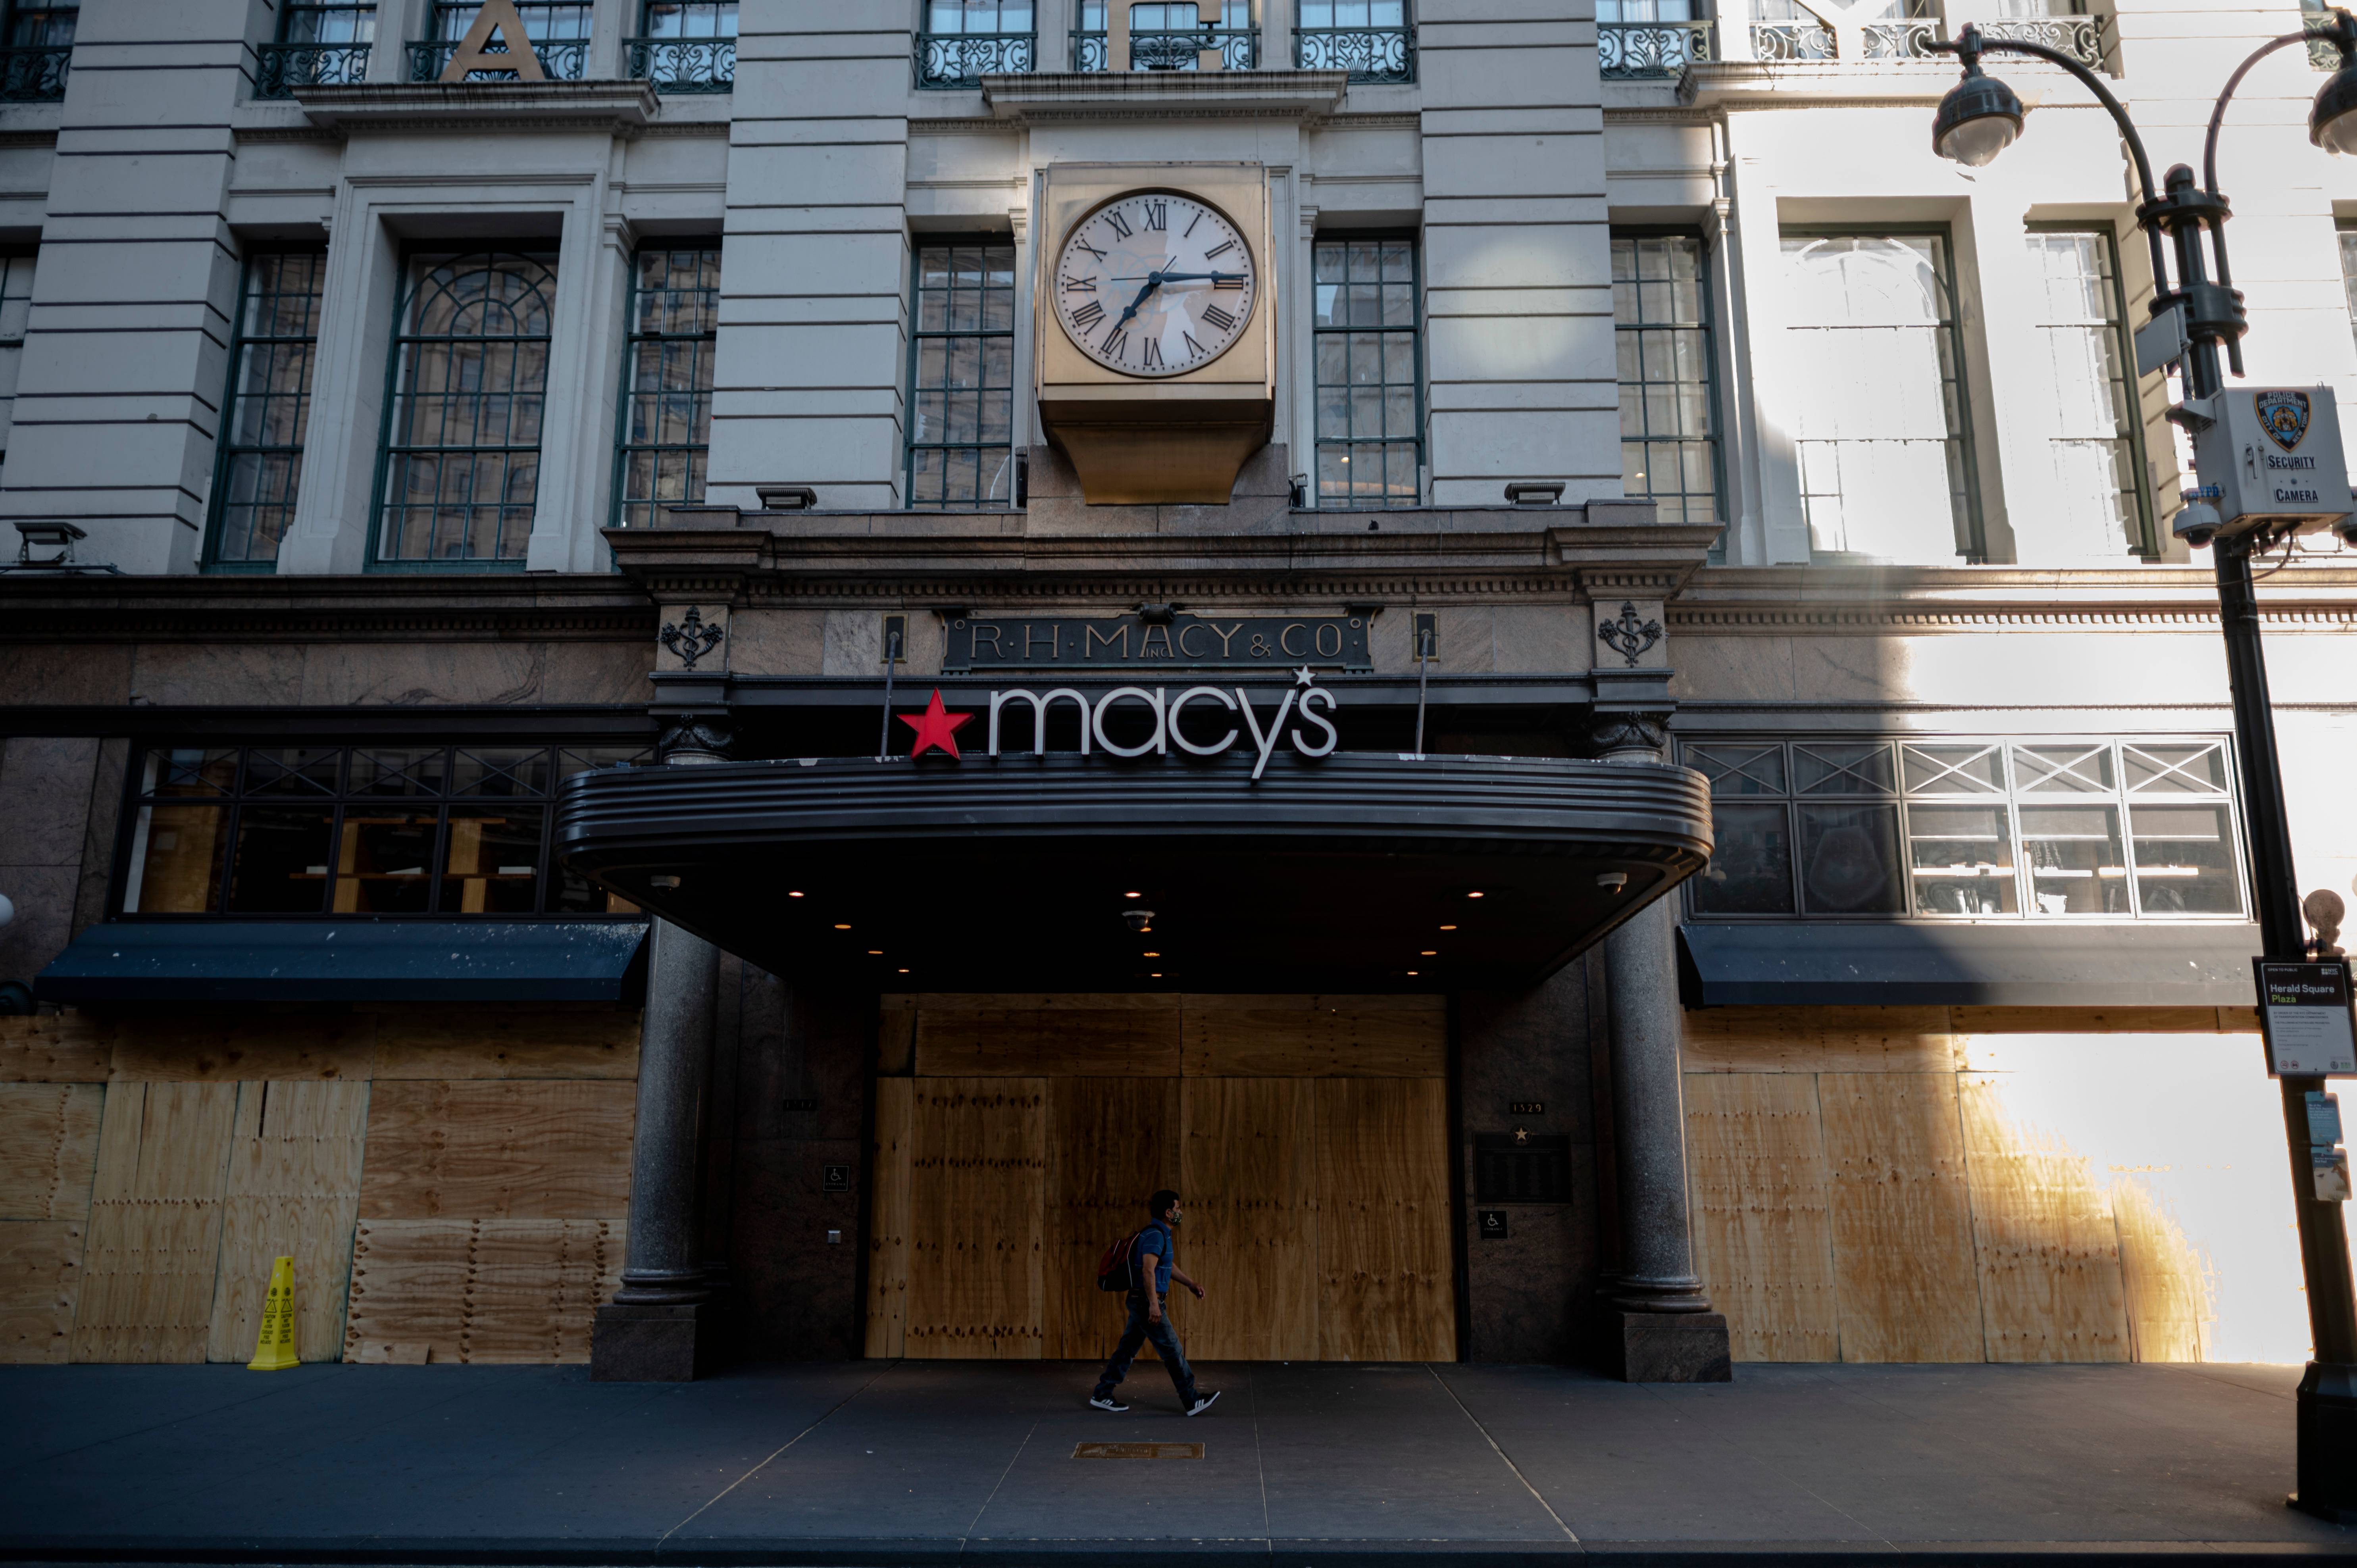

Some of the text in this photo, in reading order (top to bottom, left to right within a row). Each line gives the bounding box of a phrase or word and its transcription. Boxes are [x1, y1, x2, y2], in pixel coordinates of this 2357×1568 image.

[439, 0, 545, 81] A
[1104, 211, 1133, 242] XI
[1144, 203, 1167, 231] XII
[1184, 212, 1202, 237] I
[1077, 239, 1107, 262] X
[1204, 240, 1234, 260] II
[1144, 337, 1164, 366] VI
[1183, 330, 1205, 358] V
[2259, 397, 2307, 409] DEPARTMENT
[2262, 416, 2273, 430] CITY
[2273, 431, 2282, 440] OF
[2292, 430, 2303, 443] NEW
[2268, 455, 2315, 468] SECURITY
[2276, 488, 2319, 502] CAMERA
[1250, 633, 1272, 658] &
[988, 663, 1337, 780] macy's
[2270, 984, 2335, 995] Herald Square
[2271, 995, 2297, 1003] Plaza
[1513, 1104, 1542, 1112] 1329
